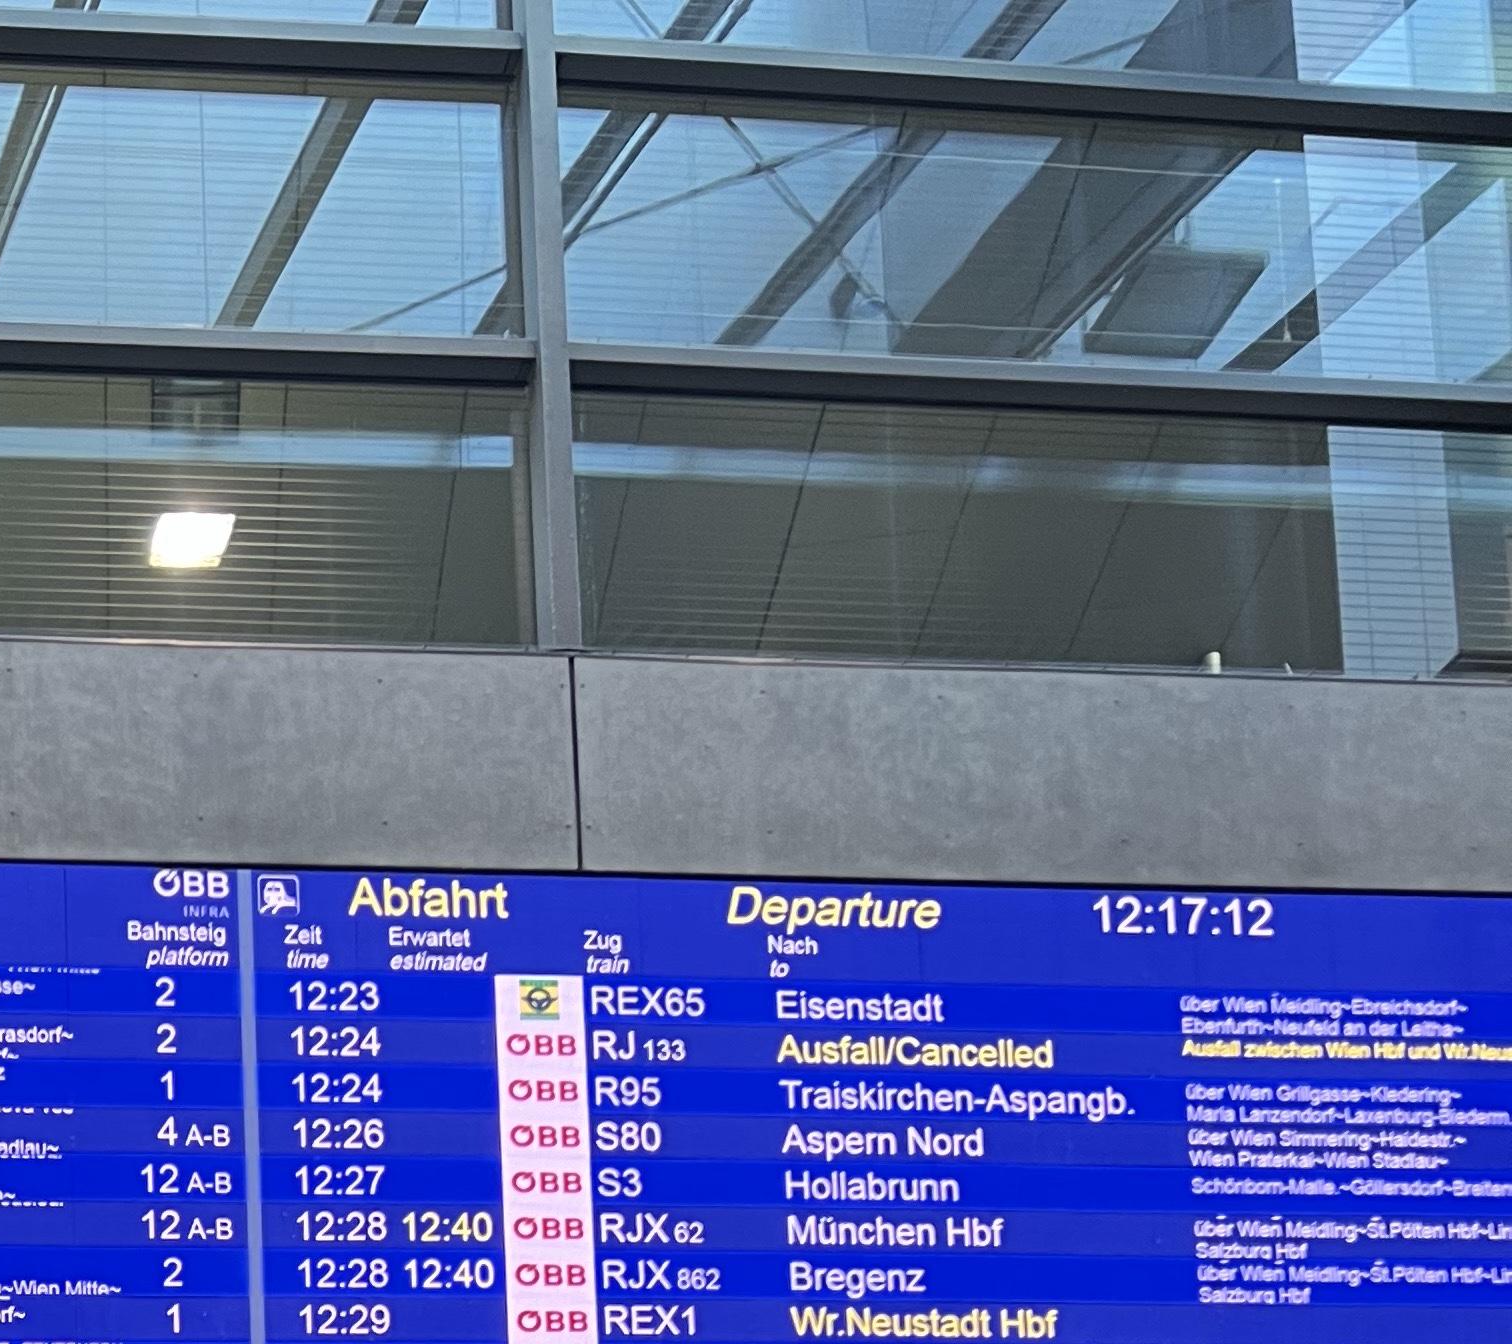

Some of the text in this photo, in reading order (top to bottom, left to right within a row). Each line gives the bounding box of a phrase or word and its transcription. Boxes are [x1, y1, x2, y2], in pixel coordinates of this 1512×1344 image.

[183, 905, 229, 918] INFRA
[348, 877, 509, 919] Abfahrt
[727, 886, 941, 935] Departure
[1093, 895, 1274, 936] 12:17:12
[128, 920, 226, 946] Bahnsteig
[284, 925, 322, 944] Zeit
[389, 926, 470, 947] Erwartet
[584, 930, 622, 954] Zug
[768, 935, 818, 954] Nach
[146, 945, 228, 969] platform
[287, 949, 329, 969] time
[390, 951, 487, 971] estimated
[587, 955, 629, 973] train
[770, 960, 789, 977] to
[156, 977, 175, 1006] 2
[290, 981, 379, 1011] 12:23
[591, 986, 704, 1016] REX65
[776, 990, 944, 1022] Eisenstadt
[157, 1023, 176, 1053] 2
[291, 1026, 381, 1056] 12:24
[593, 1030, 686, 1061] RJ 133
[777, 1034, 1054, 1068] Ausfall/Cancelled
[161, 1071, 173, 1100] 1
[292, 1073, 382, 1102] 12:24
[595, 1076, 661, 1106] R95
[779, 1080, 1134, 1122] Traiskirchen-Aspangb.
[157, 1116, 230, 1146] 4 A-B
[294, 1118, 384, 1148] 12:26
[596, 1121, 661, 1152] S80
[782, 1124, 984, 1161] Aspern Nord
[142, 1164, 231, 1193] 12 A-B
[296, 1165, 384, 1195] 12:27
[598, 1168, 642, 1197] S3
[785, 1171, 959, 1201] Hollabrunn
[142, 1209, 233, 1240] 12 A-B
[297, 1211, 493, 1242] 12:28 12:40
[600, 1213, 704, 1243] RJX 62
[787, 1215, 1004, 1246] München Hbf
[164, 1258, 182, 1286] 2
[298, 1259, 494, 1288] 12:28 12:40
[602, 1260, 720, 1290] RJX 862
[790, 1262, 925, 1299] Bregenz
[167, 1303, 180, 1333] 1
[300, 1304, 390, 1334] 12:29
[604, 1305, 695, 1335] REX1
[790, 1306, 1058, 1338] Wr.Neustadt Hbf
